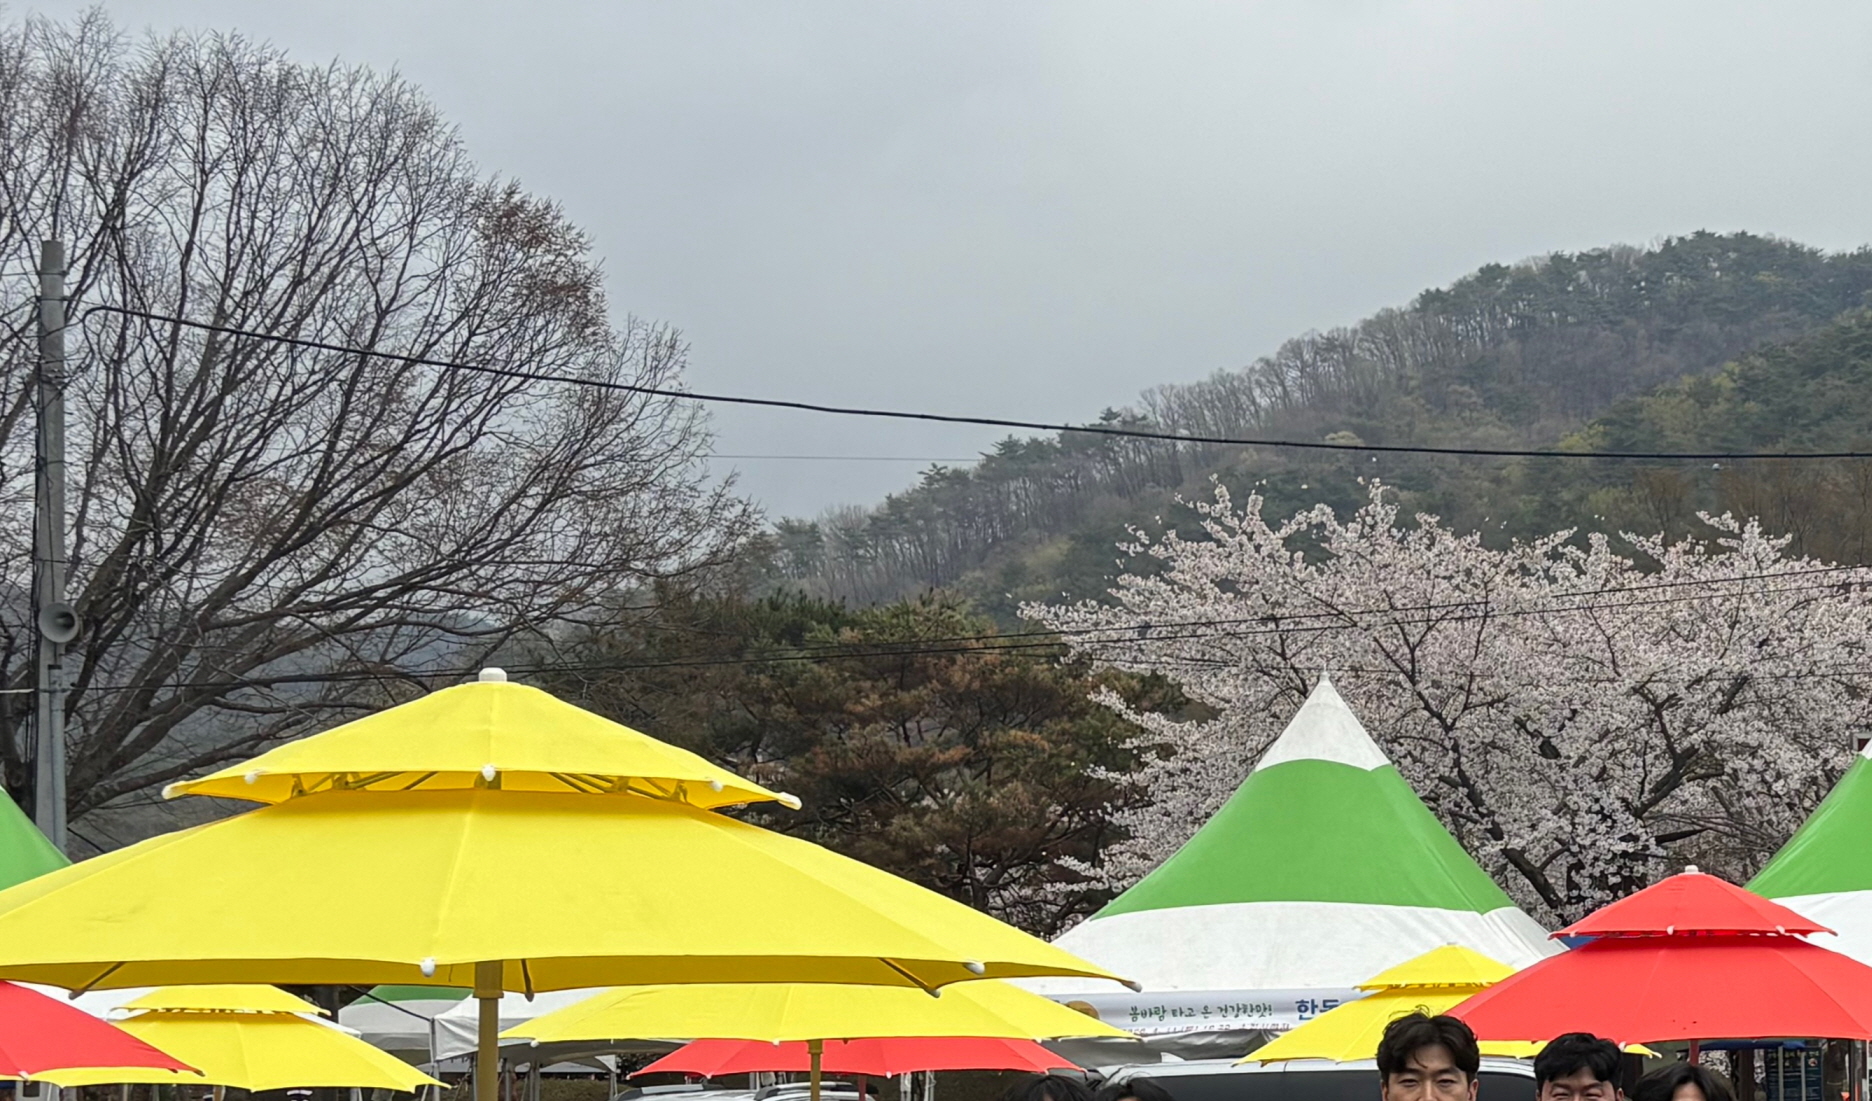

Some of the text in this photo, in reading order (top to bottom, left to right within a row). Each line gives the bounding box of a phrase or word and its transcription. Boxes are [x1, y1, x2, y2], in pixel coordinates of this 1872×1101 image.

[1129, 1003, 1273, 1022] 봄바람 타고 온 건강한맛!
